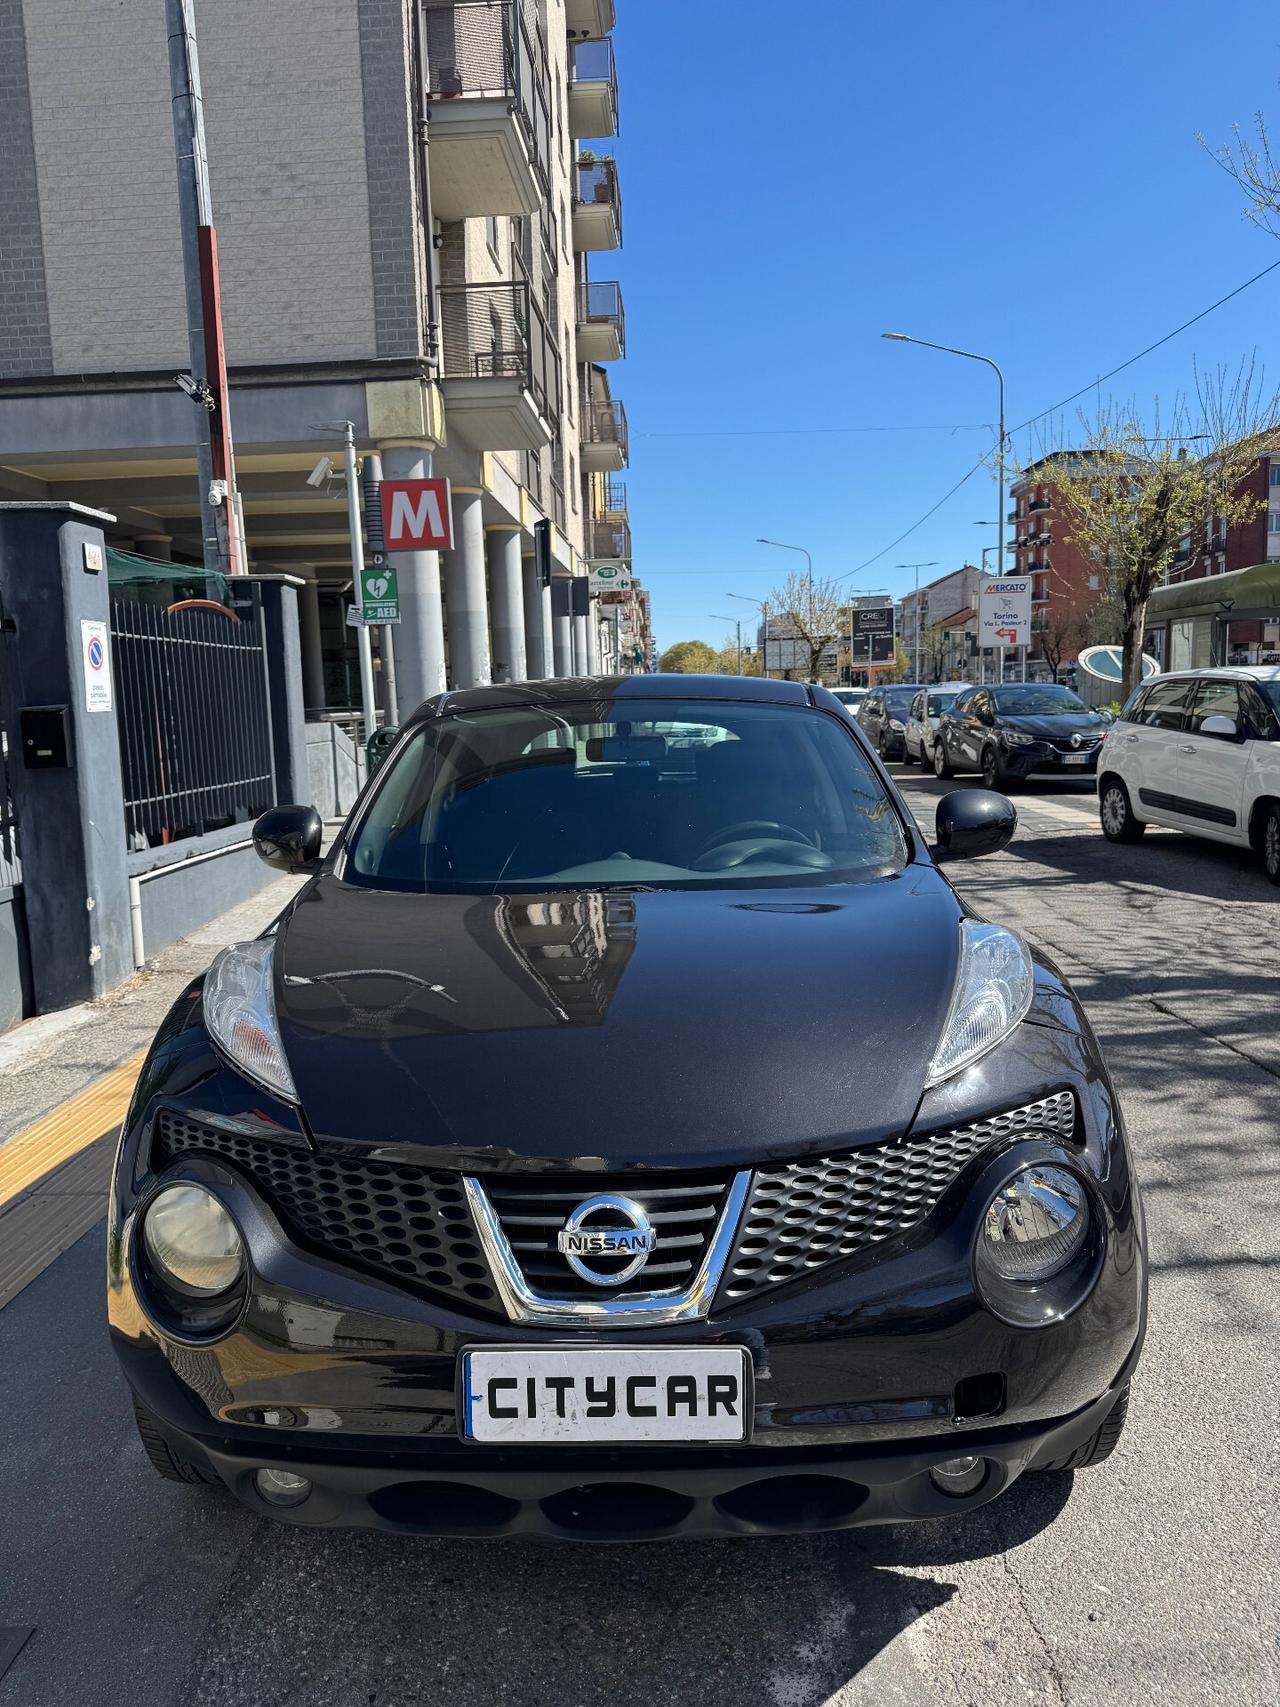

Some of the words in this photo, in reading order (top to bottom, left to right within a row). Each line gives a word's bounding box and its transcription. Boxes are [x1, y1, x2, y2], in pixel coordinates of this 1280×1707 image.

[390, 490, 445, 539] M
[377, 607, 397, 618] AED
[568, 1236, 646, 1250] NISSAN
[488, 1375, 738, 1419] CITYCAR
